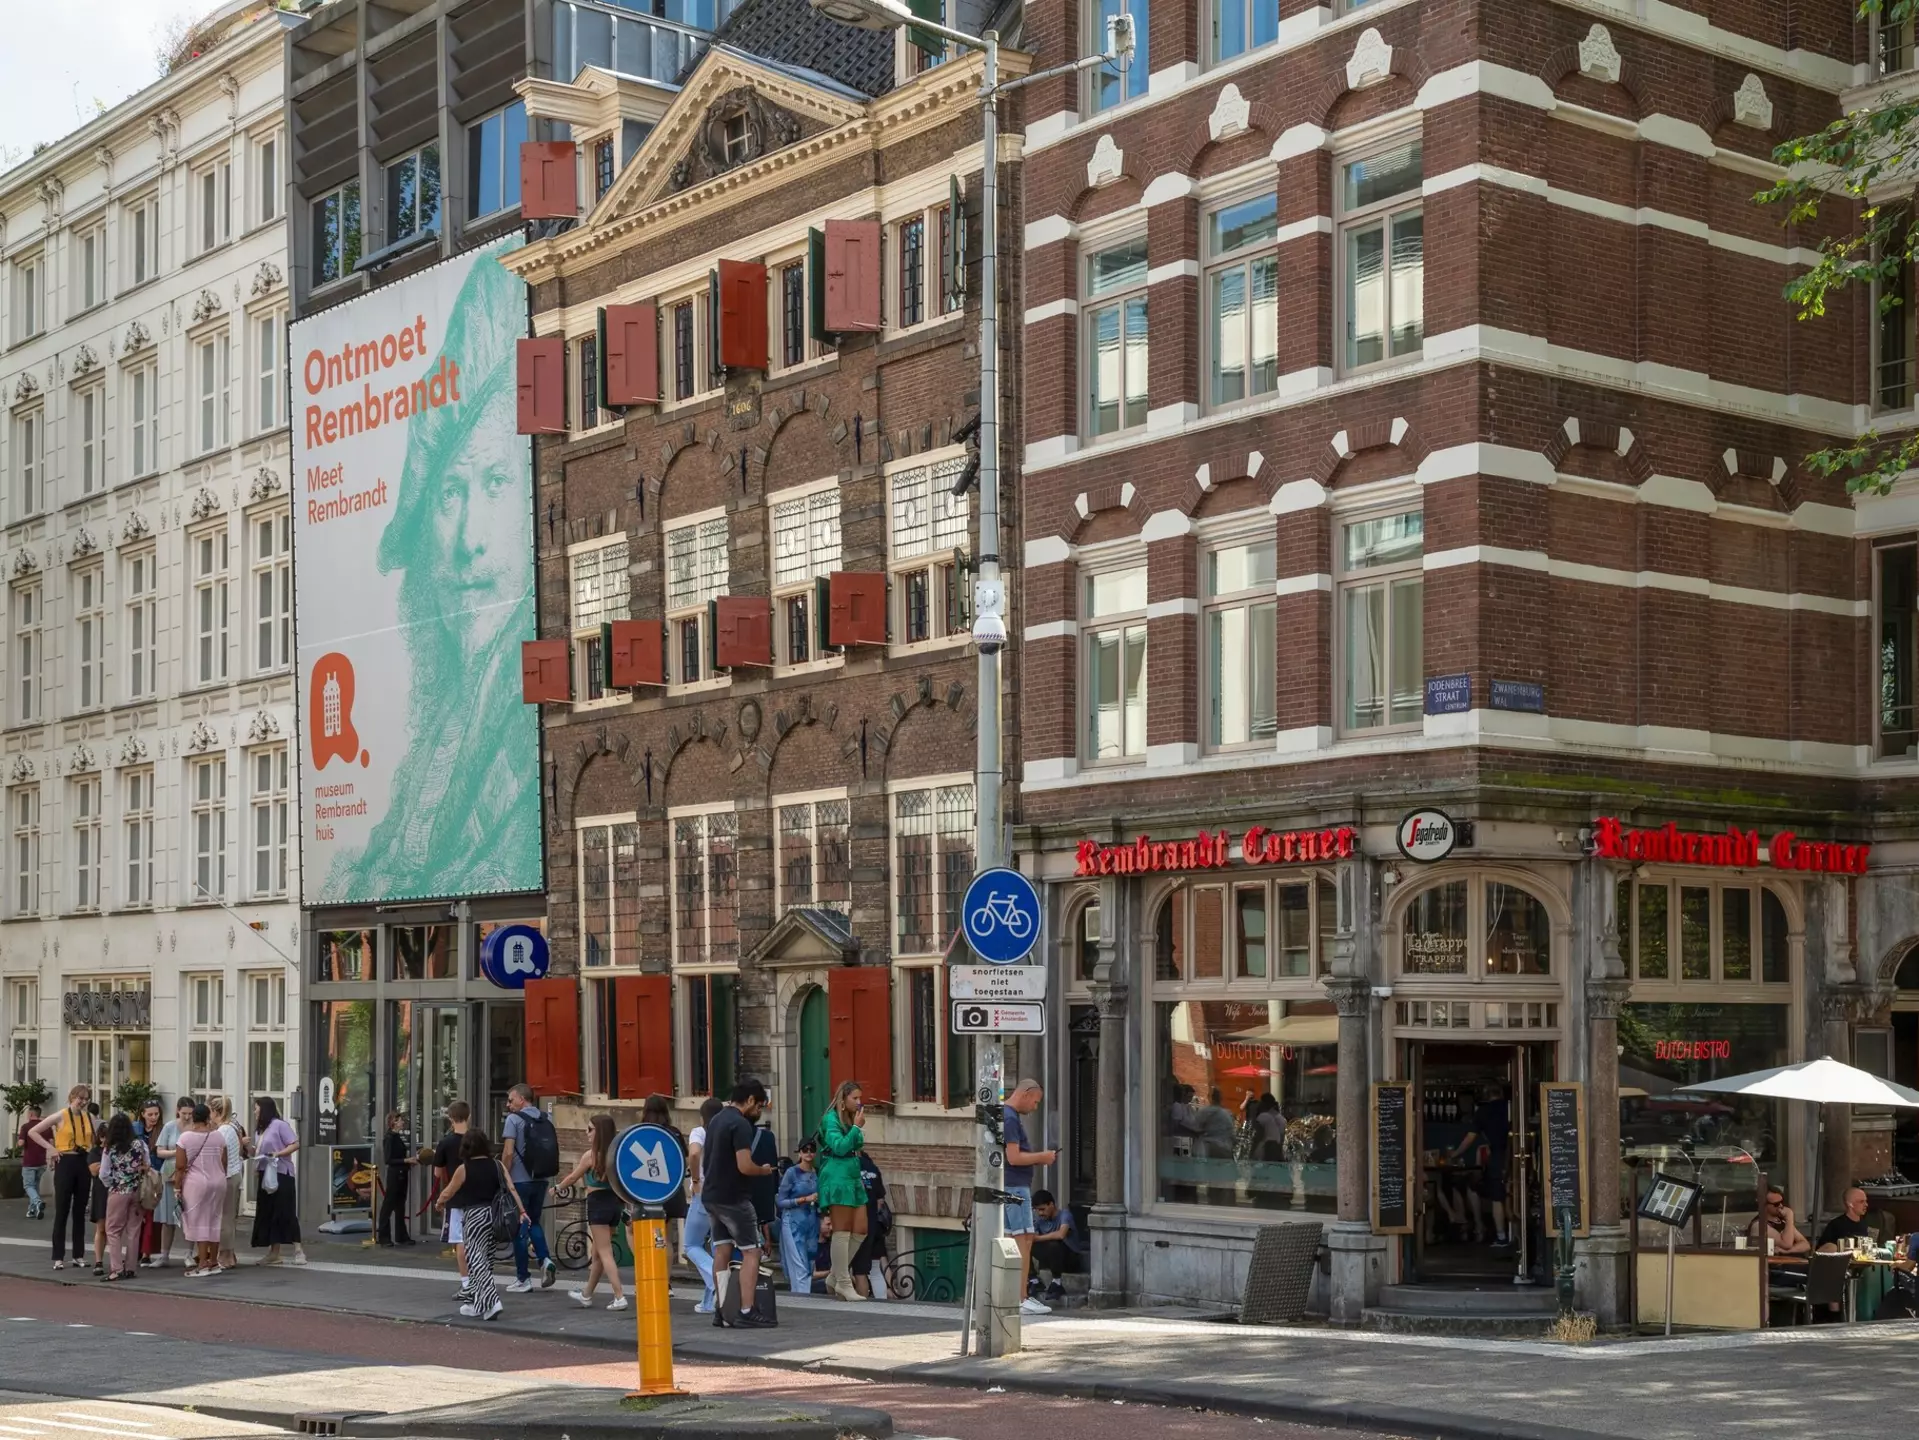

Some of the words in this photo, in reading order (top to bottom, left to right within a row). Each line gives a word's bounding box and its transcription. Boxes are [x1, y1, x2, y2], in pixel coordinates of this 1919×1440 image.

[304, 314, 428, 396] Ontmoet
[305, 356, 461, 450] Rembrandt
[732, 400, 751, 416] 1606
[307, 462, 344, 491] Meet
[307, 478, 388, 524] Rembrandt
[1428, 677, 1468, 694] JODENBREE
[1493, 683, 1540, 698] ZWANENBURG
[1435, 690, 1460, 703] STRAAT
[1494, 696, 1508, 707] WAL
[1444, 702, 1467, 711] CENTRUM
[315, 783, 353, 799] museum
[315, 800, 367, 819] Rembrandt
[315, 822, 335, 841] huis
[1406, 818, 1449, 848] Segafredo
[1074, 828, 1231, 877] Rembrandt
[1242, 825, 1357, 865] Corner
[1591, 816, 1761, 868] Rembrandt
[1768, 830, 1871, 875] Corner
[1412, 954, 1463, 963] TRAPPIST
[972, 968, 1024, 976] snorfietsen
[991, 978, 1009, 986] niet
[974, 988, 1024, 997] toegestaan
[1216, 1042, 1253, 1060] DUTCH
[1656, 1040, 1692, 1060] DUTCH
[1693, 1039, 1731, 1060] BISTRO
